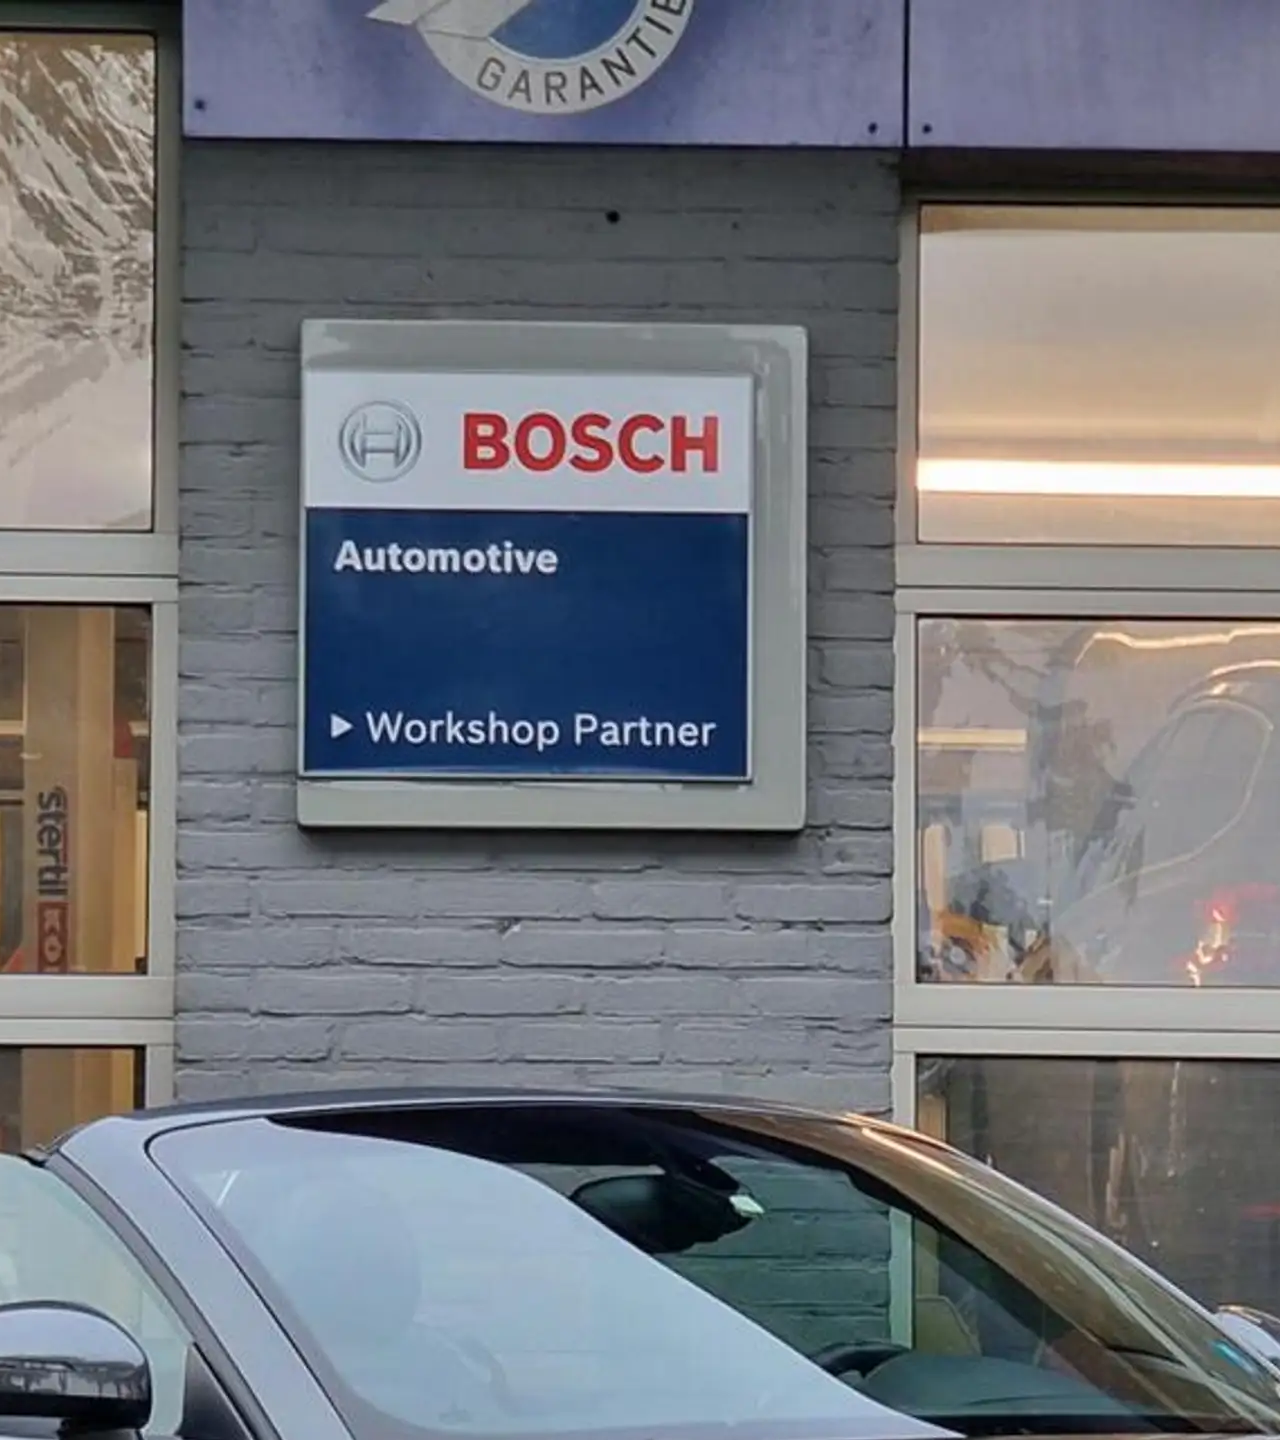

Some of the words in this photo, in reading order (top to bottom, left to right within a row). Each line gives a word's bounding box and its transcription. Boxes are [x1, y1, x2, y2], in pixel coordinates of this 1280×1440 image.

[477, 0, 686, 104] GARANTIE
[463, 411, 718, 473] BOSCH
[334, 540, 559, 574] Automotive
[366, 710, 560, 752] Workshop
[574, 713, 717, 748] Partner
[37, 790, 68, 895] stertil
[40, 905, 66, 973] KO
